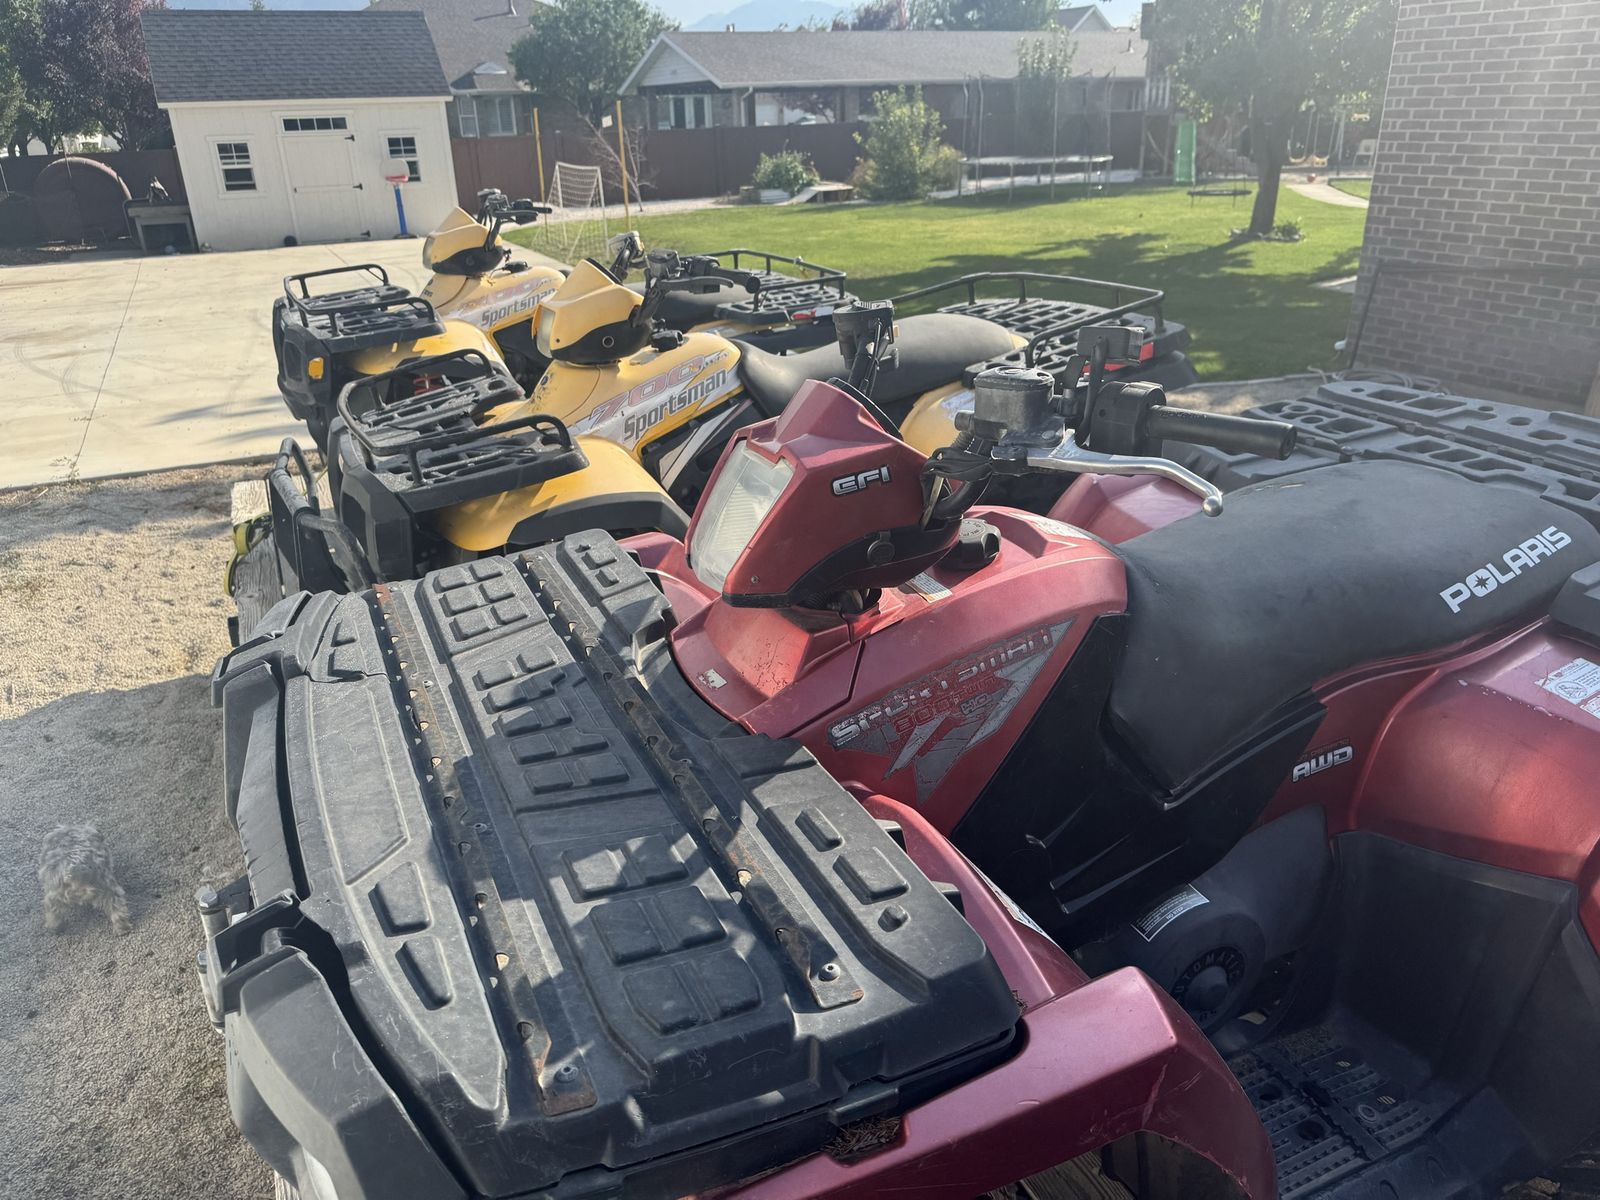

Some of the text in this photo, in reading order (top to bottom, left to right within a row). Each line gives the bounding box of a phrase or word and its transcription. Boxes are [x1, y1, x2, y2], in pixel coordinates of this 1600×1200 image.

[481, 287, 556, 327] Sportsman
[623, 369, 727, 441] Sportsman
[832, 465, 890, 496] EFI
[1440, 525, 1572, 614] POLARIS
[1292, 745, 1353, 783] AWD
[1175, 951, 1241, 1001] UTOMATIC
